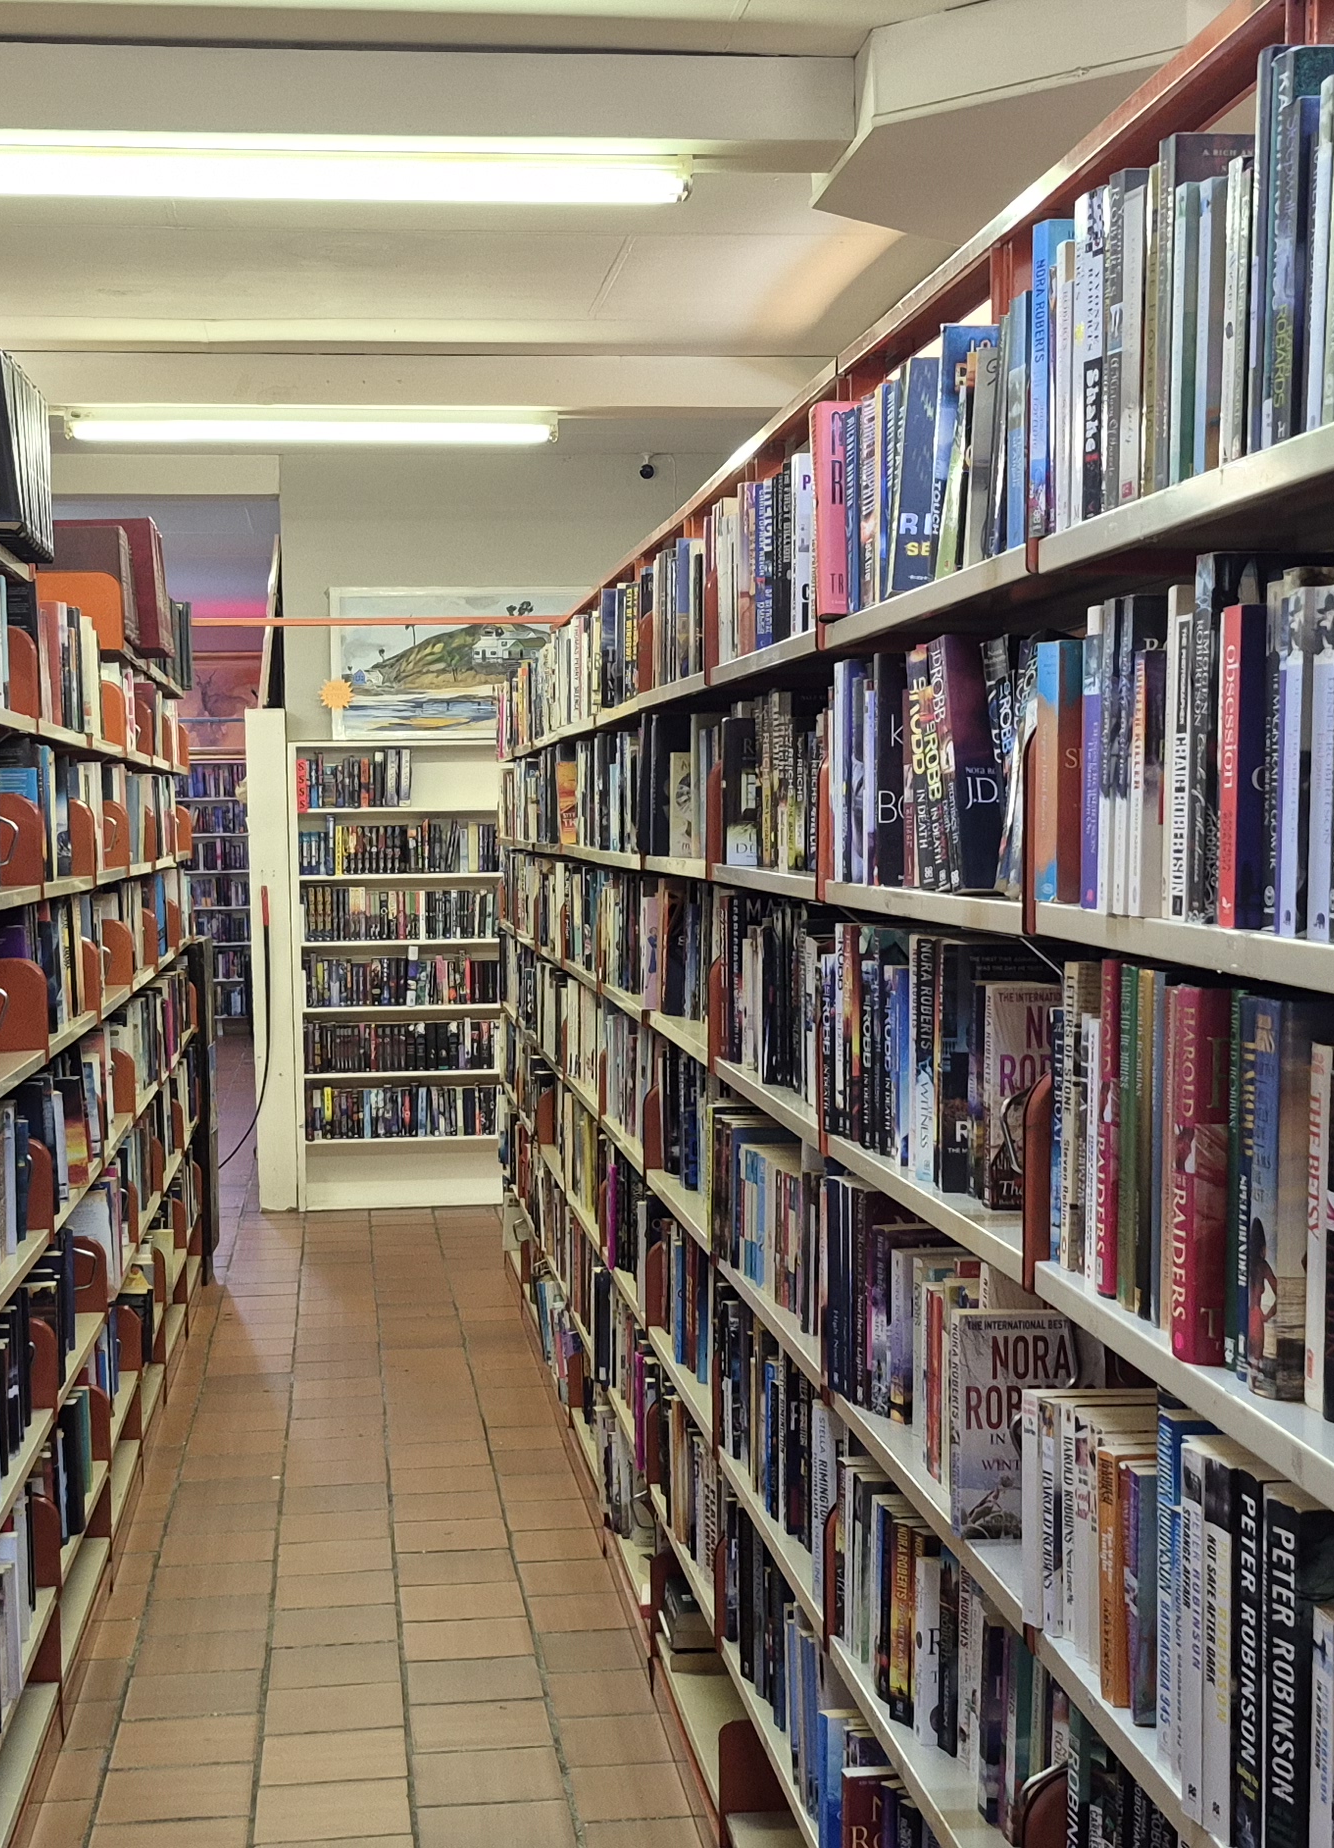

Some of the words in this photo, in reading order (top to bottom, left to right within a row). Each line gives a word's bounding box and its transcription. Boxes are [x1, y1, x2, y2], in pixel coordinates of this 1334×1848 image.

[1035, 258, 1046, 297] NORA
[1033, 301, 1046, 365] ROBERTS
[1272, 303, 1289, 410] ROBARDS
[1085, 367, 1100, 454] Shake
[931, 479, 944, 535] TOUCH
[1223, 644, 1241, 790] obsession
[923, 729, 942, 802] ROBB
[965, 777, 1000, 811] J.D.
[920, 942, 933, 985] NORA
[919, 988, 933, 1051] ROBERTS
[997, 992, 1014, 1002] THE
[1066, 975, 1076, 1033] LETTERS
[1100, 973, 1113, 1074] HAROLD
[1064, 1061, 1073, 1116] STONE
[1181, 1007, 1197, 1119] HAROLD
[919, 1083, 929, 1151] WITNESS
[1095, 1142, 1107, 1260] RAIDERS
[1305, 1152, 1323, 1243] BETSY
[1171, 1184, 1187, 1323] RAIDERS
[950, 1323, 961, 1359] NORA
[983, 1320, 1045, 1331] INTERNATIONAL
[990, 1333, 1073, 1381] NORA
[950, 1361, 961, 1421] ROBERTS
[818, 1416, 827, 1454] STELLA
[989, 1432, 1005, 1445] IN
[820, 1459, 831, 1526] RIMINGTON
[896, 1523, 906, 1549] NORA
[1181, 1507, 1192, 1558] STRANGE
[1206, 1534, 1217, 1559] NOT
[1240, 1492, 1257, 1599] PETER
[895, 1551, 907, 1600] ROBERTS
[1205, 1563, 1217, 1597] SAFE
[1271, 1525, 1296, 1629] PETER
[1192, 1556, 1203, 1670] ROBINSON
[1205, 1599, 1217, 1641] AFTER
[1205, 1644, 1216, 1685] DARK
[1238, 1601, 1257, 1769] ROBINSON
[1271, 1635, 1295, 1806] ROBINSON
